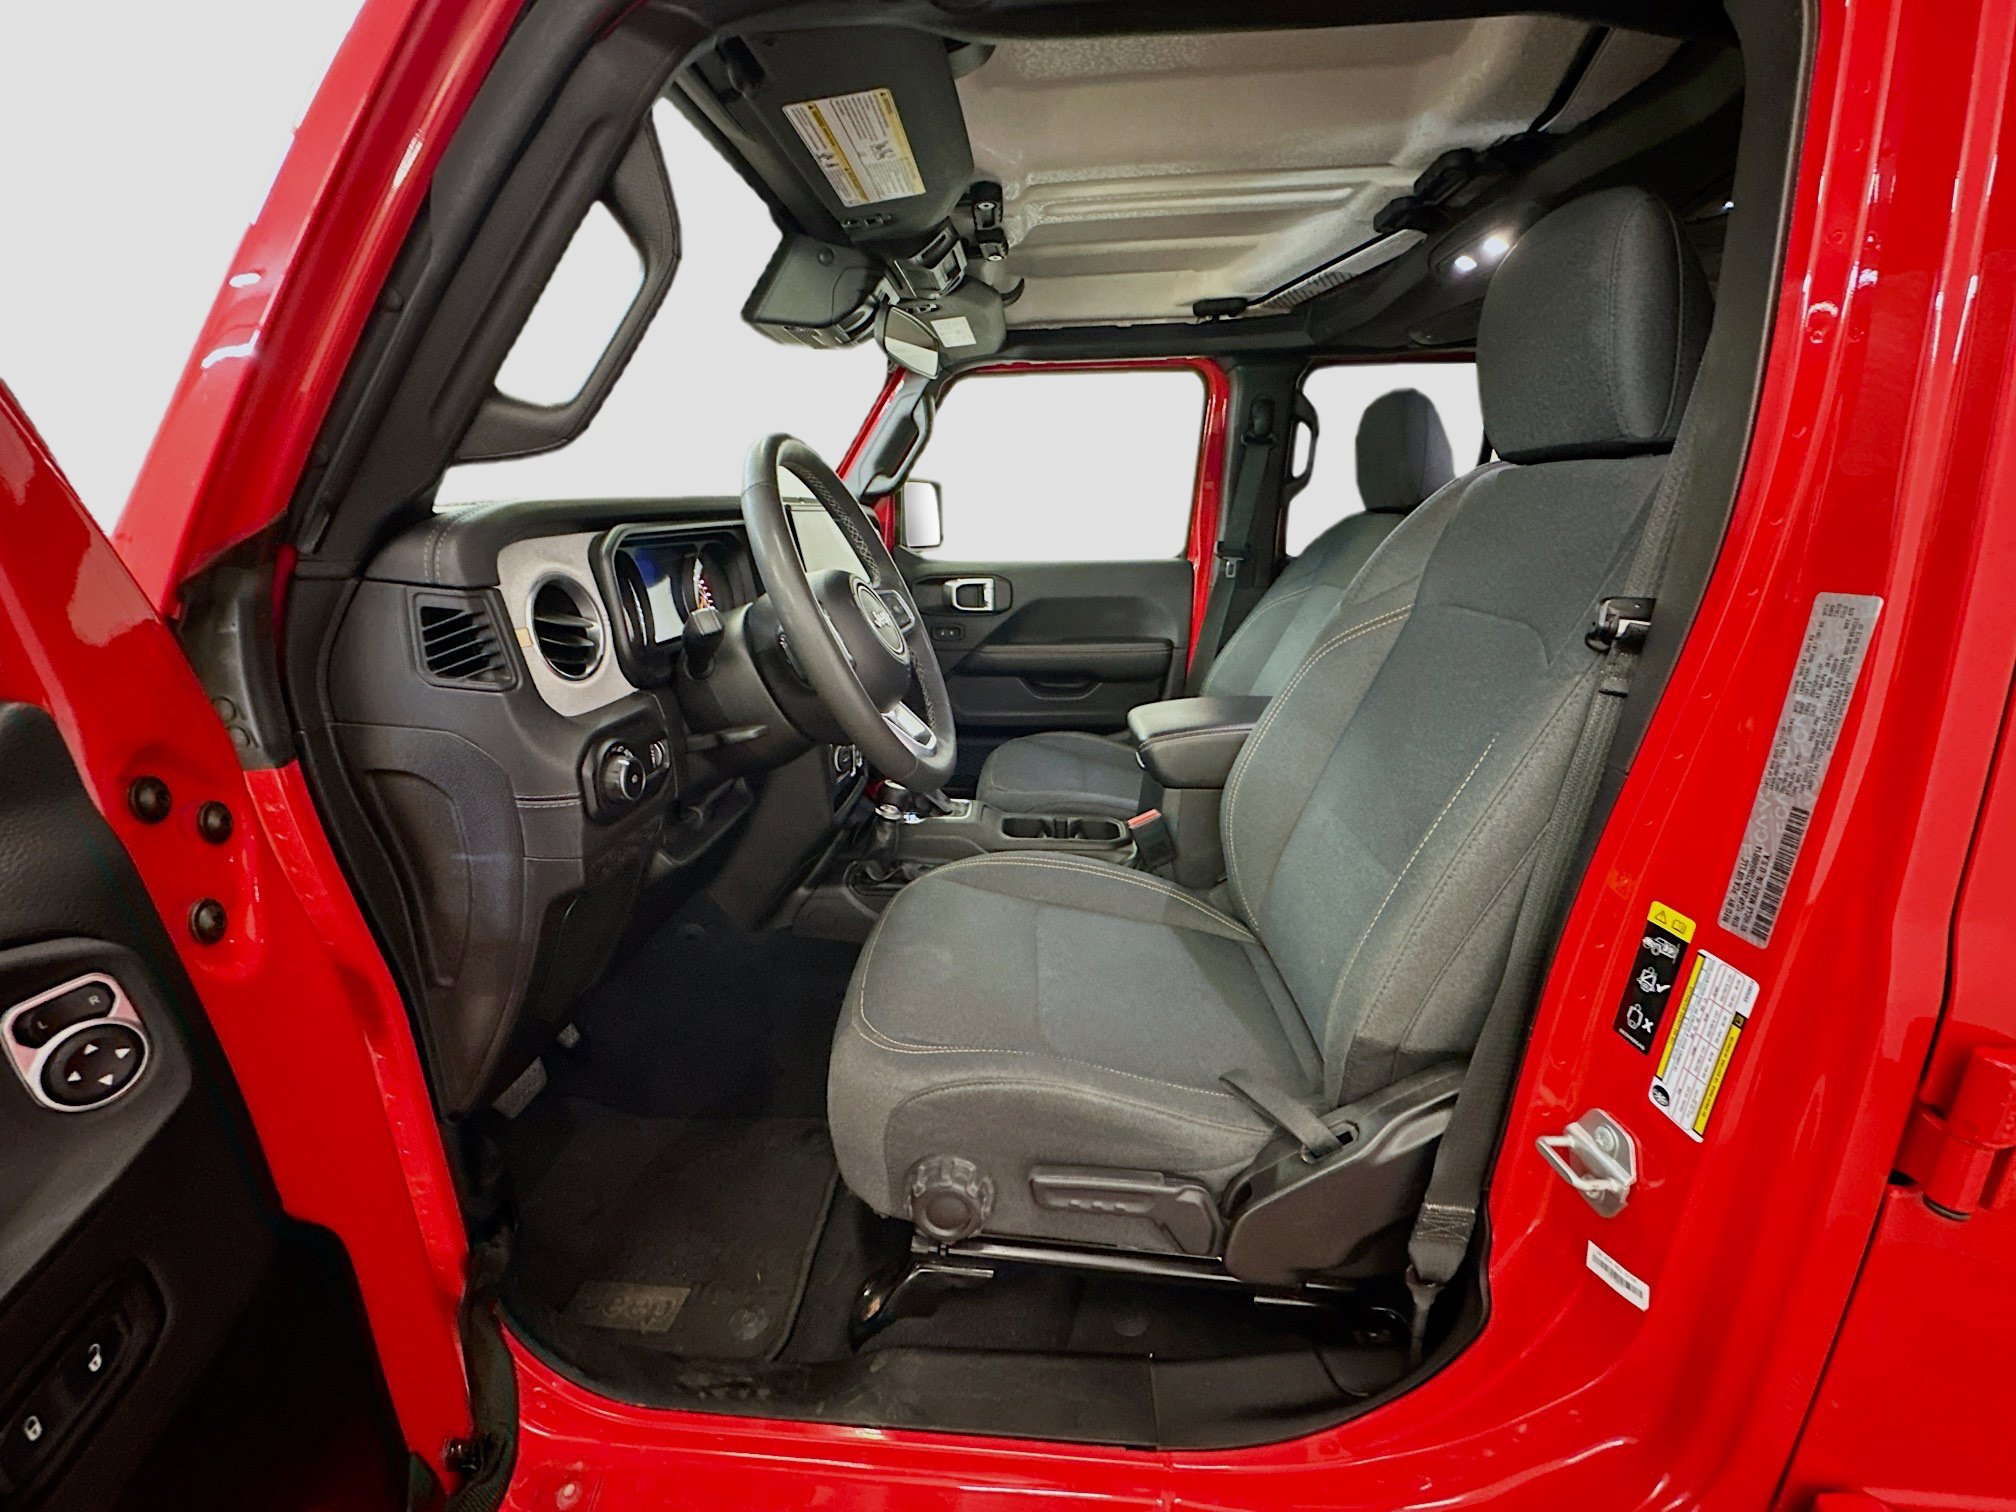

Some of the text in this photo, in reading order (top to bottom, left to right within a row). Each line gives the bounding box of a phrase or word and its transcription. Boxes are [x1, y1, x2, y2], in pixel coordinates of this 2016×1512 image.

[1739, 857, 1750, 871] LLC
[1735, 870, 1745, 881] US
[1731, 881, 1741, 895] FCA
[1740, 905, 1753, 932] VEHICLE
[1748, 885, 1761, 905] MADE
[87, 995, 101, 1006] R
[37, 1021, 48, 1030] L
